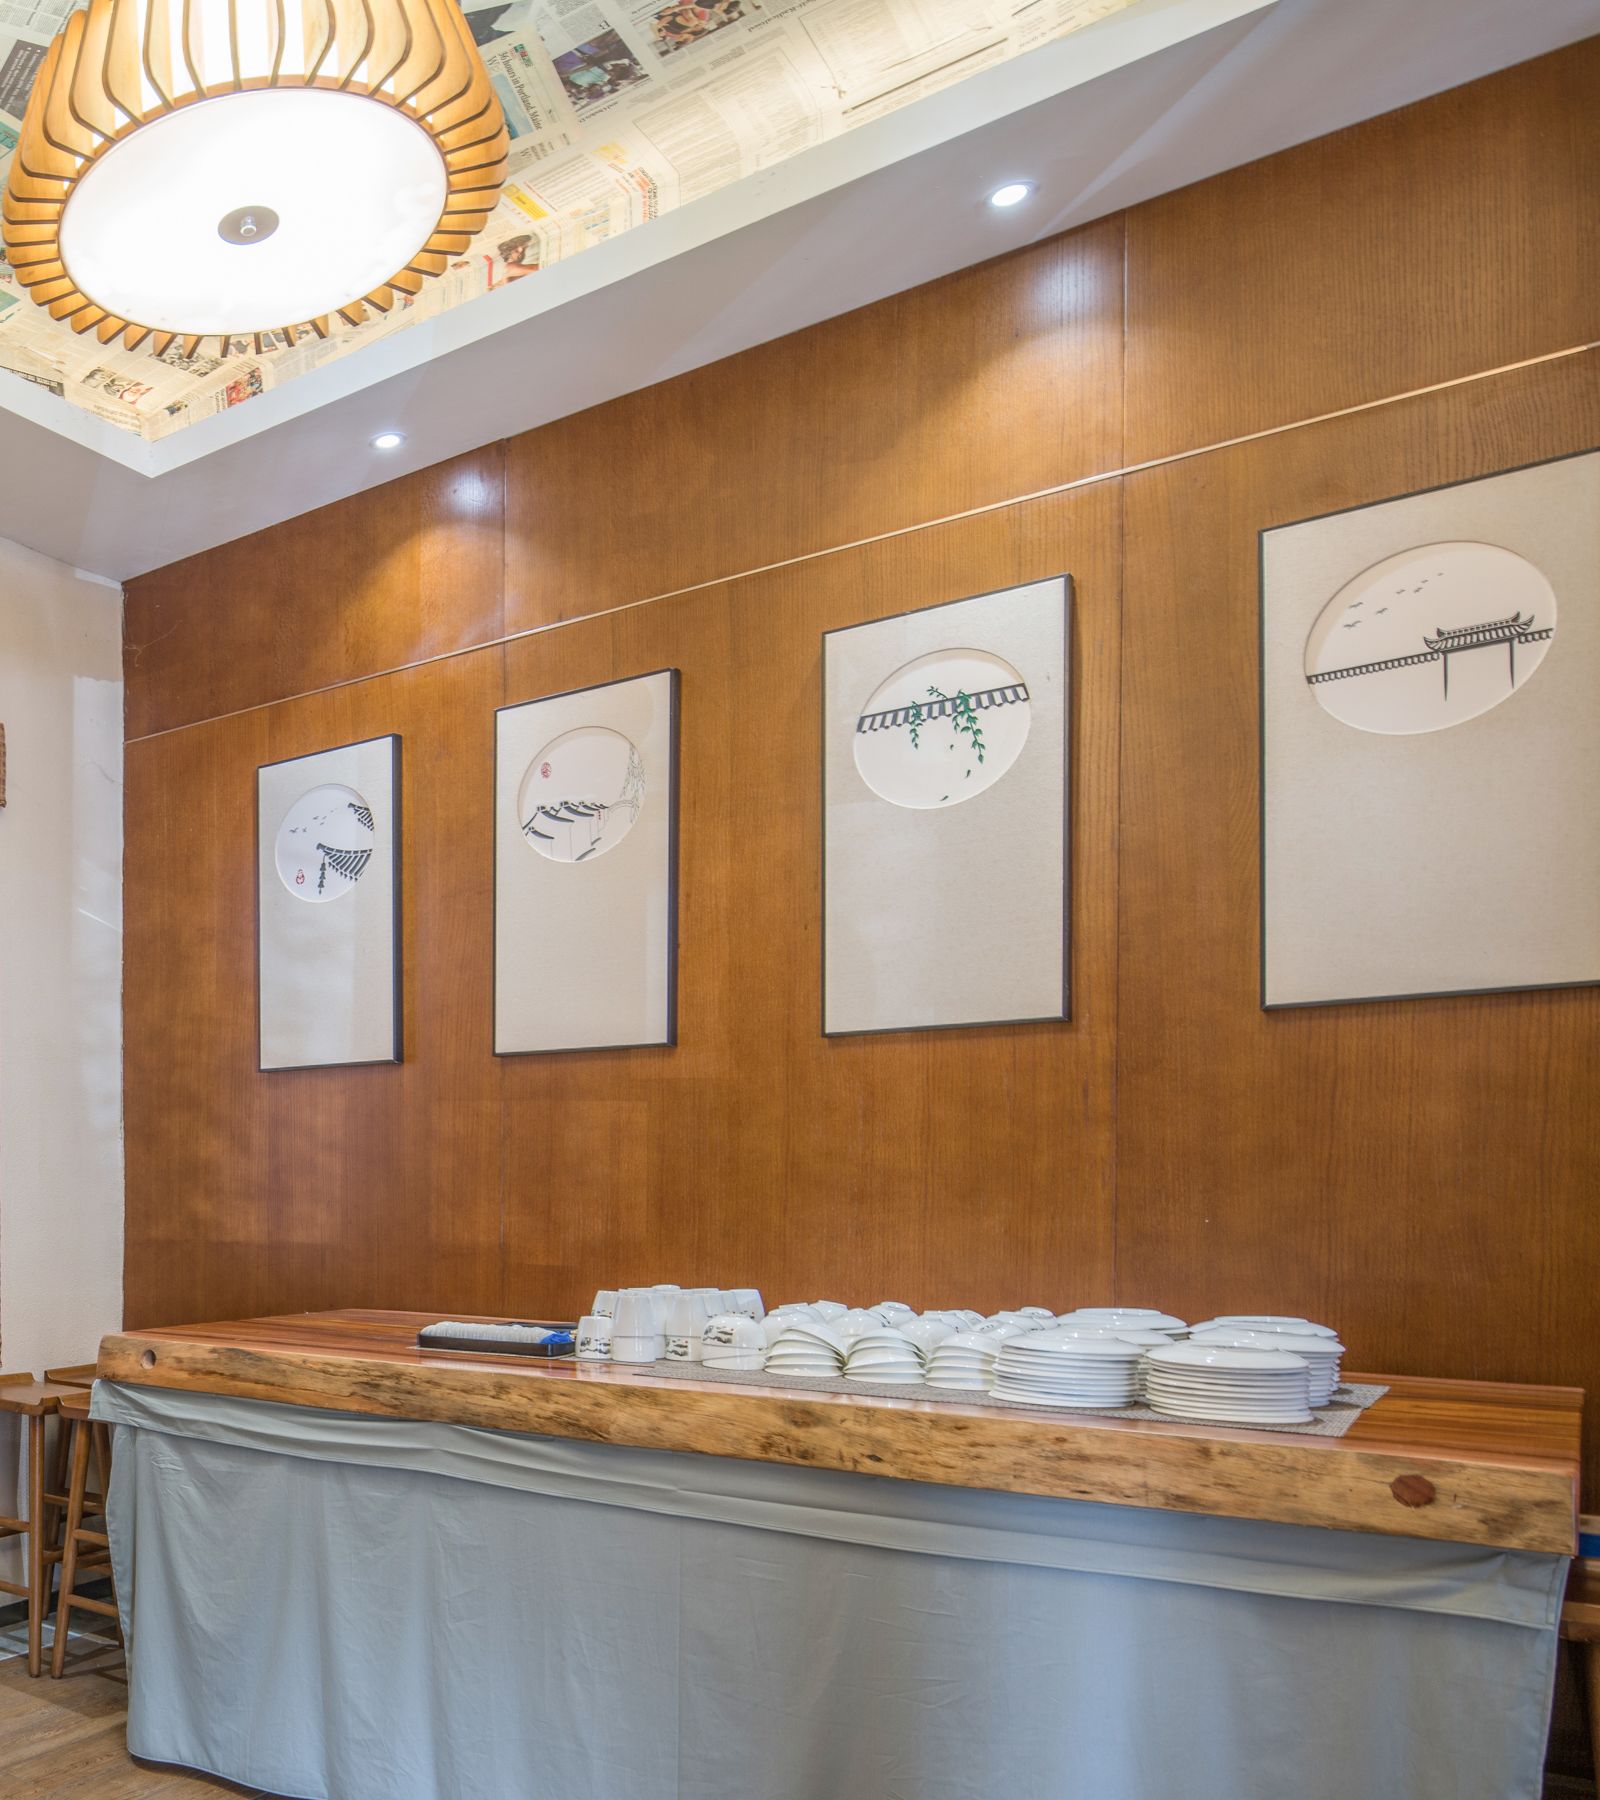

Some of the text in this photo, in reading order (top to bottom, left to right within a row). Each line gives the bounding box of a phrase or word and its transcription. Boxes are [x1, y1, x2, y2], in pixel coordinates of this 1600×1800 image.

[499, 50, 510, 61] 36
[502, 58, 518, 78] hours
[529, 111, 543, 131] Maine
